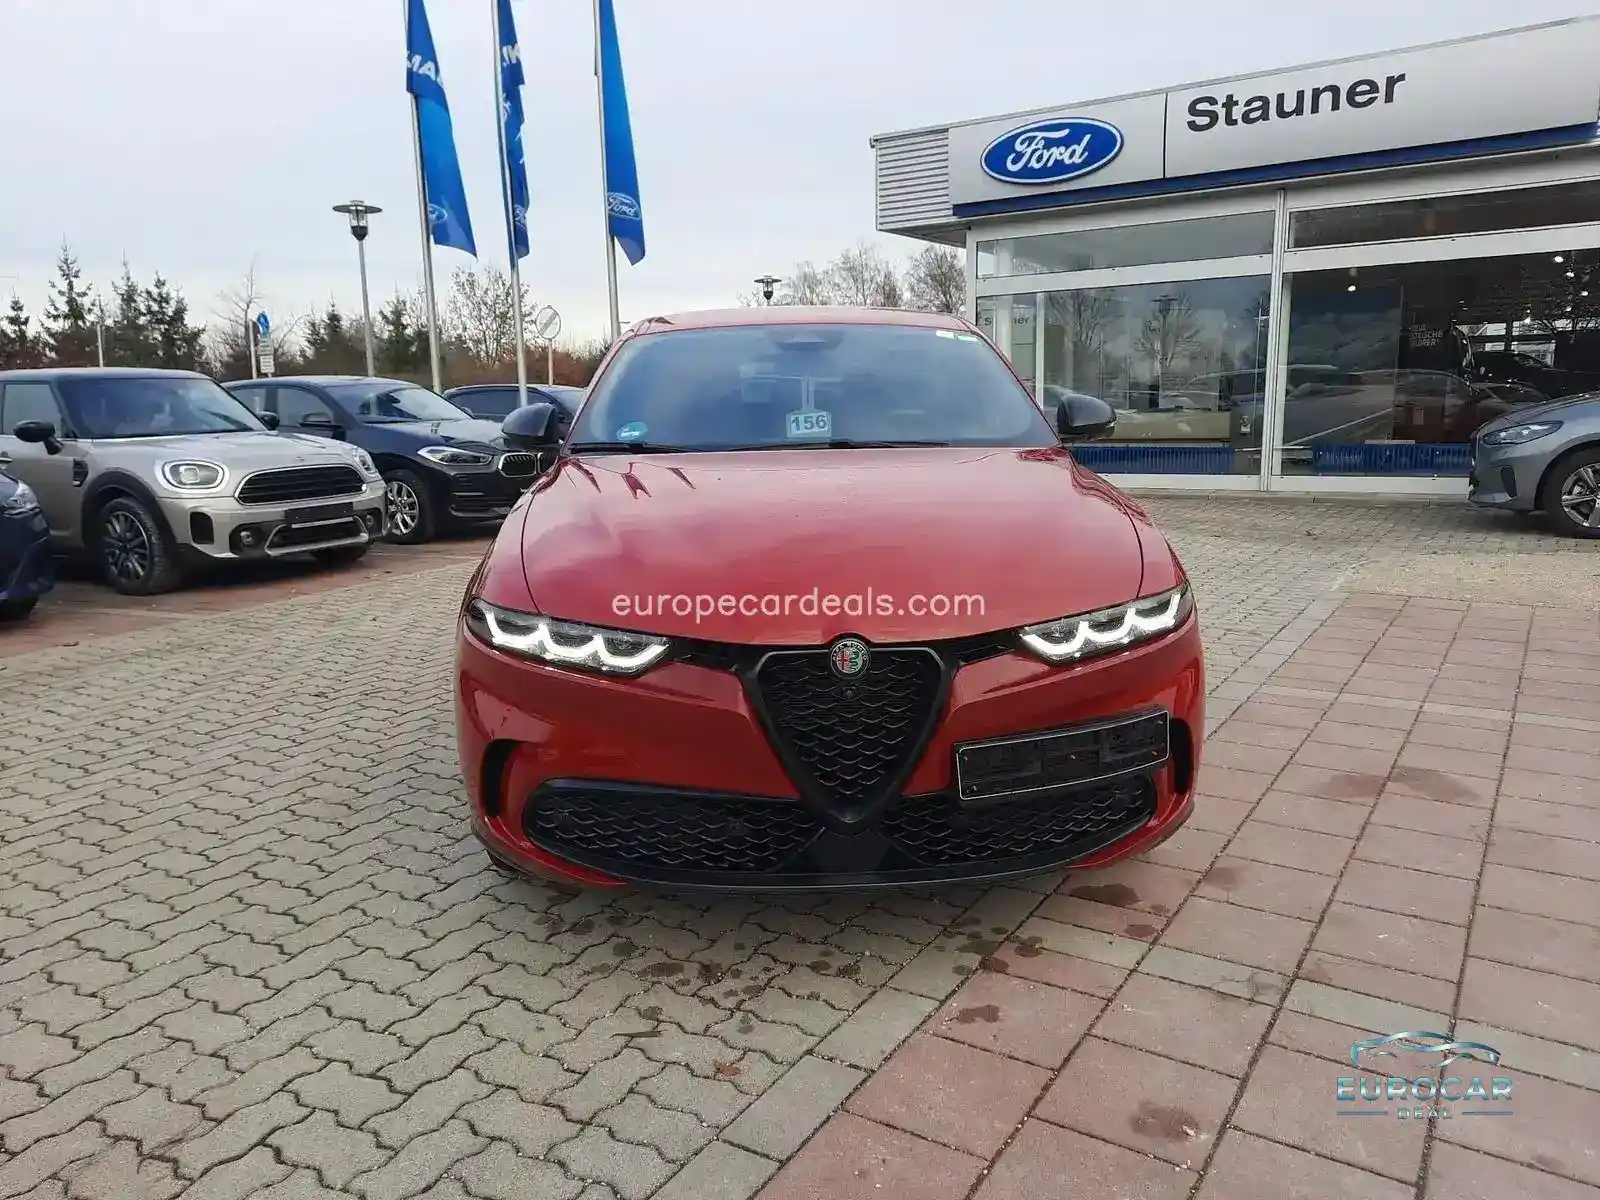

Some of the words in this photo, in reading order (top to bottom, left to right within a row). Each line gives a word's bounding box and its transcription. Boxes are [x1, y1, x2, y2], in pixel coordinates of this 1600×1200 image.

[1186, 73, 1406, 132] Stauner
[1006, 128, 1092, 172] Ford
[791, 415, 827, 431] 156
